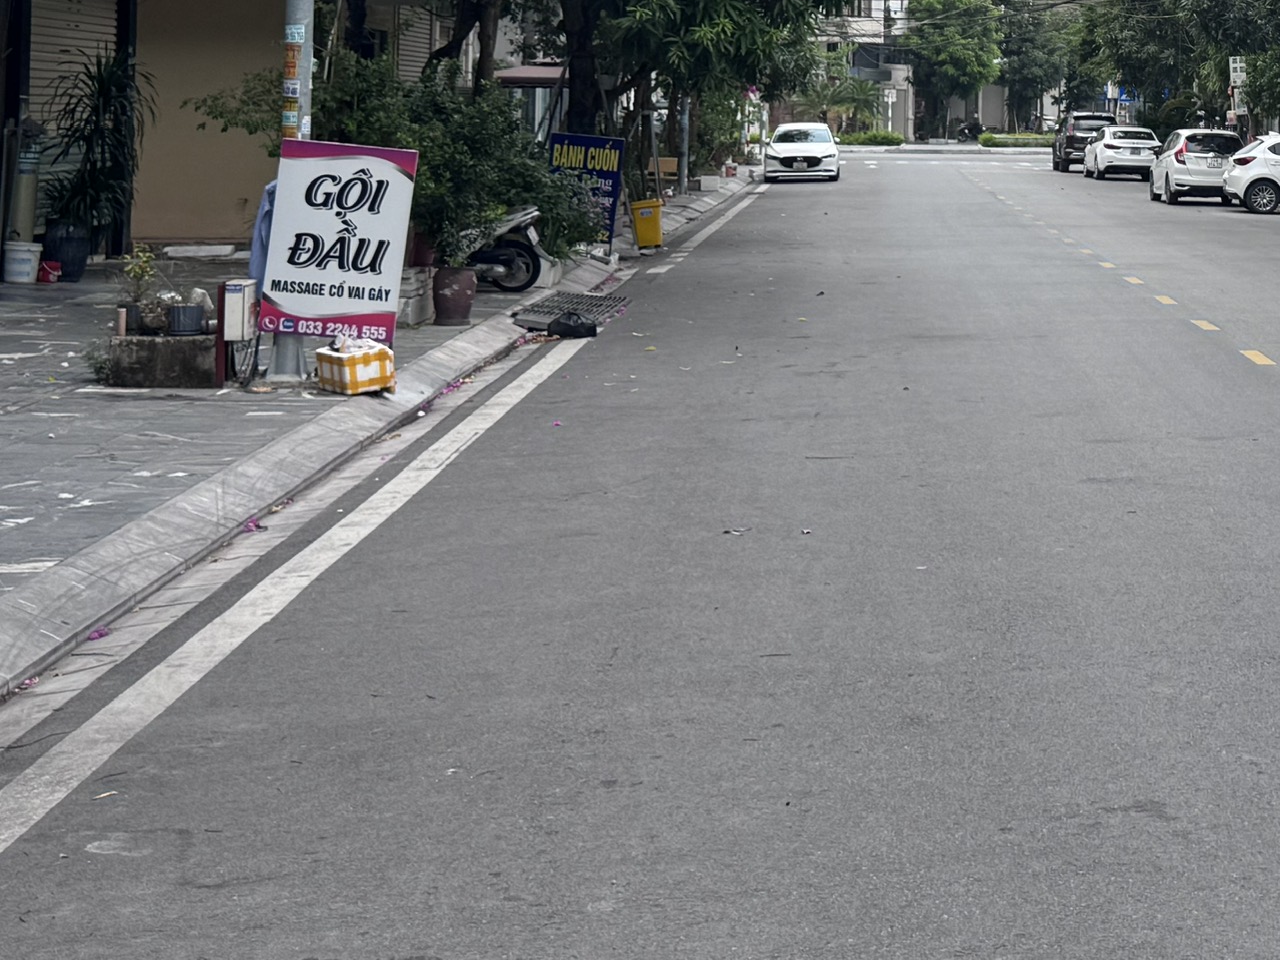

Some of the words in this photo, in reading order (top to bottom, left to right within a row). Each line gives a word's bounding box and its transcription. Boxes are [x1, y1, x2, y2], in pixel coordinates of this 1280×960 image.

[553, 140, 586, 168] BÁNH
[588, 142, 620, 172] CUỐN
[304, 167, 390, 218] GỘI
[287, 218, 391, 276] ĐẦU
[270, 279, 326, 296] MASSAGE
[348, 286, 365, 300] VAI
[368, 285, 392, 302] GÁY
[298, 320, 323, 335] 033
[361, 325, 387, 340] 555
